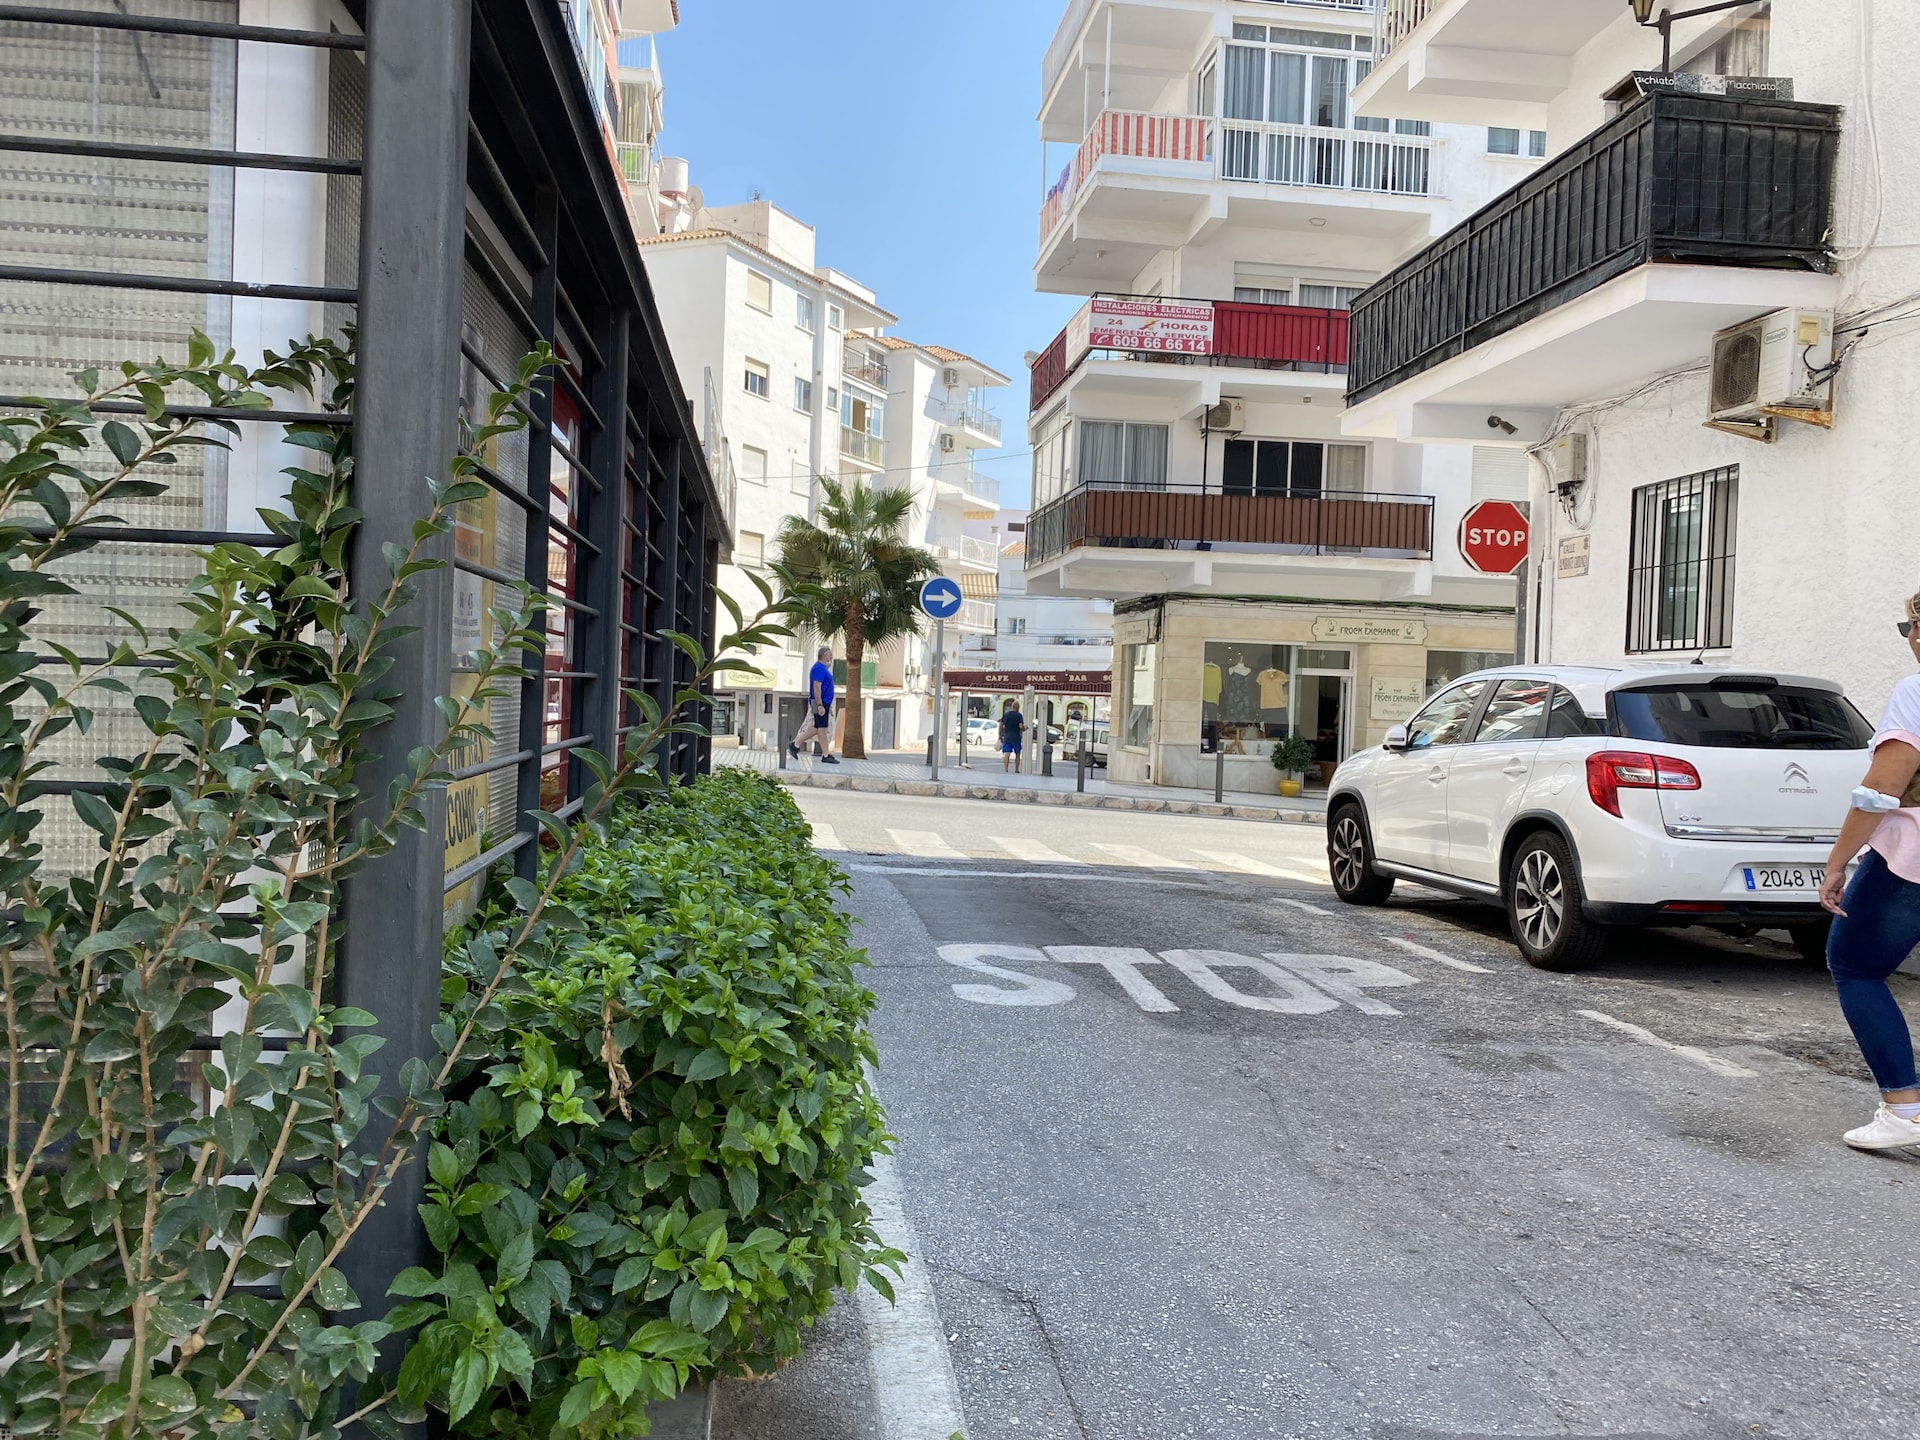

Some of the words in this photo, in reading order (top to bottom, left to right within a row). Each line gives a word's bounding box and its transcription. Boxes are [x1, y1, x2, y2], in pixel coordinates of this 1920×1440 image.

[1094, 301, 1157, 311] INSTALACIONES
[1161, 306, 1210, 315] ELECTRICAS
[1095, 308, 1146, 316] REPARACIONES
[1153, 312, 1209, 320] MANTENIMIENTO
[1094, 327, 1158, 337] EMERGENCY
[1165, 332, 1208, 340] SERVICE
[1161, 322, 1208, 332] HORAS
[1112, 335, 1139, 347] 609
[1143, 337, 1161, 349] 66
[1165, 338, 1183, 350] 66
[1188, 340, 1206, 352] 14
[1468, 527, 1526, 547] STOP
[985, 674, 1009, 682] CAFE
[1026, 674, 1056, 682] SNACK
[1069, 674, 1088, 682] BAR
[1759, 869, 1805, 888] 2048
[936, 942, 1421, 1017] STOP
